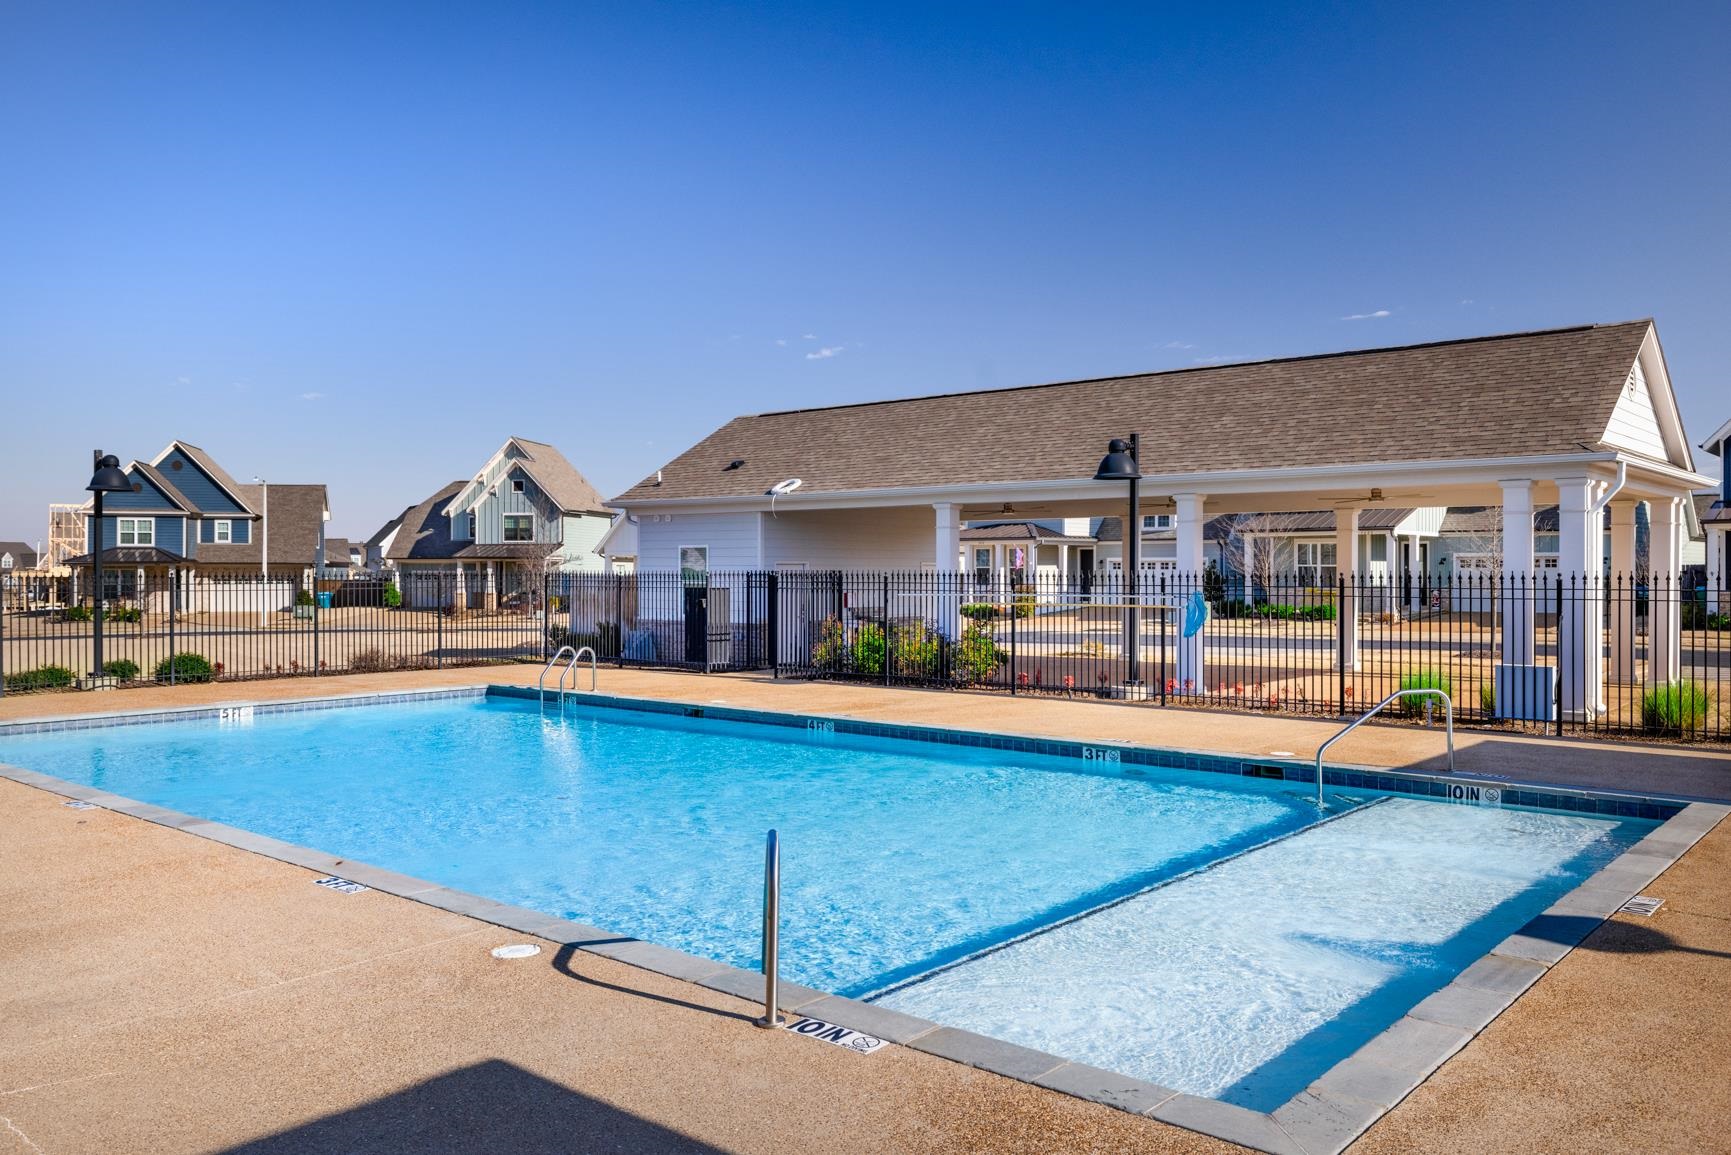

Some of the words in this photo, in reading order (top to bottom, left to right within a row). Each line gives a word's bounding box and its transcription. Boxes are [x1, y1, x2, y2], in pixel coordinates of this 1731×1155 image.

[222, 708, 228, 718] 5
[1085, 748, 1093, 759] 3
[1096, 749, 1106, 760] FT
